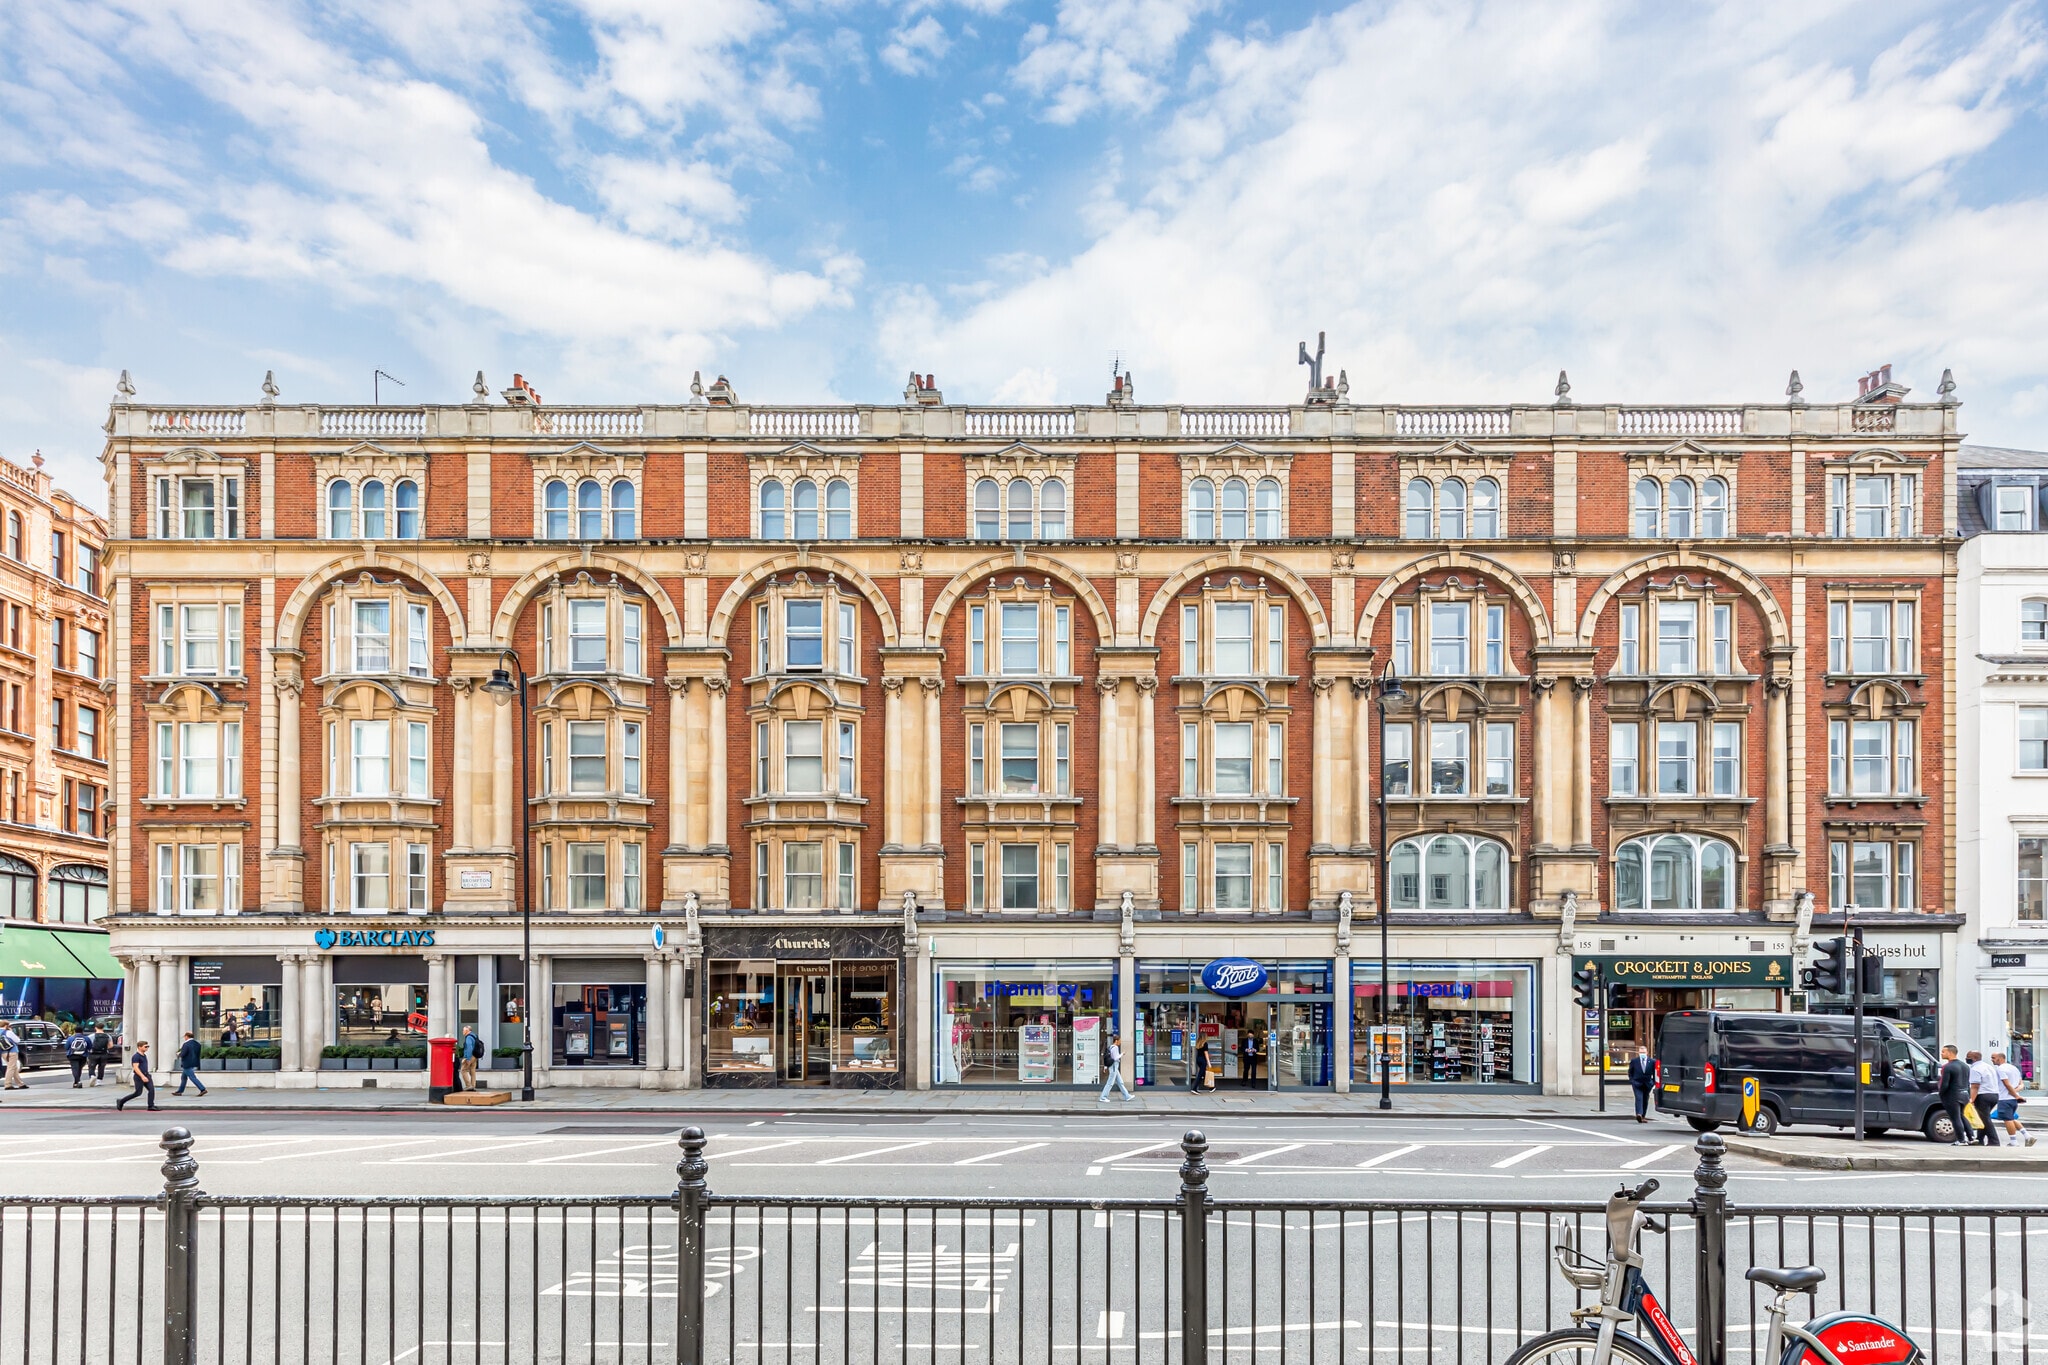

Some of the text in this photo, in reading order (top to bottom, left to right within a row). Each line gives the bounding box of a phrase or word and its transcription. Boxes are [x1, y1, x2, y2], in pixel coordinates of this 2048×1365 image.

[340, 930, 435, 946] BARCLAYS
[775, 938, 831, 949] Church's
[1846, 944, 1926, 957] sglass hut
[1614, 960, 1752, 975] CROCKETT & JONES
[1211, 964, 1259, 989] Boots
[984, 980, 1077, 999] pharmacy
[1406, 980, 1472, 999] beauty
[539, 1245, 767, 1298] BUS
[1659, 1317, 1679, 1346] Santander
[1847, 1338, 1896, 1352] Santander
